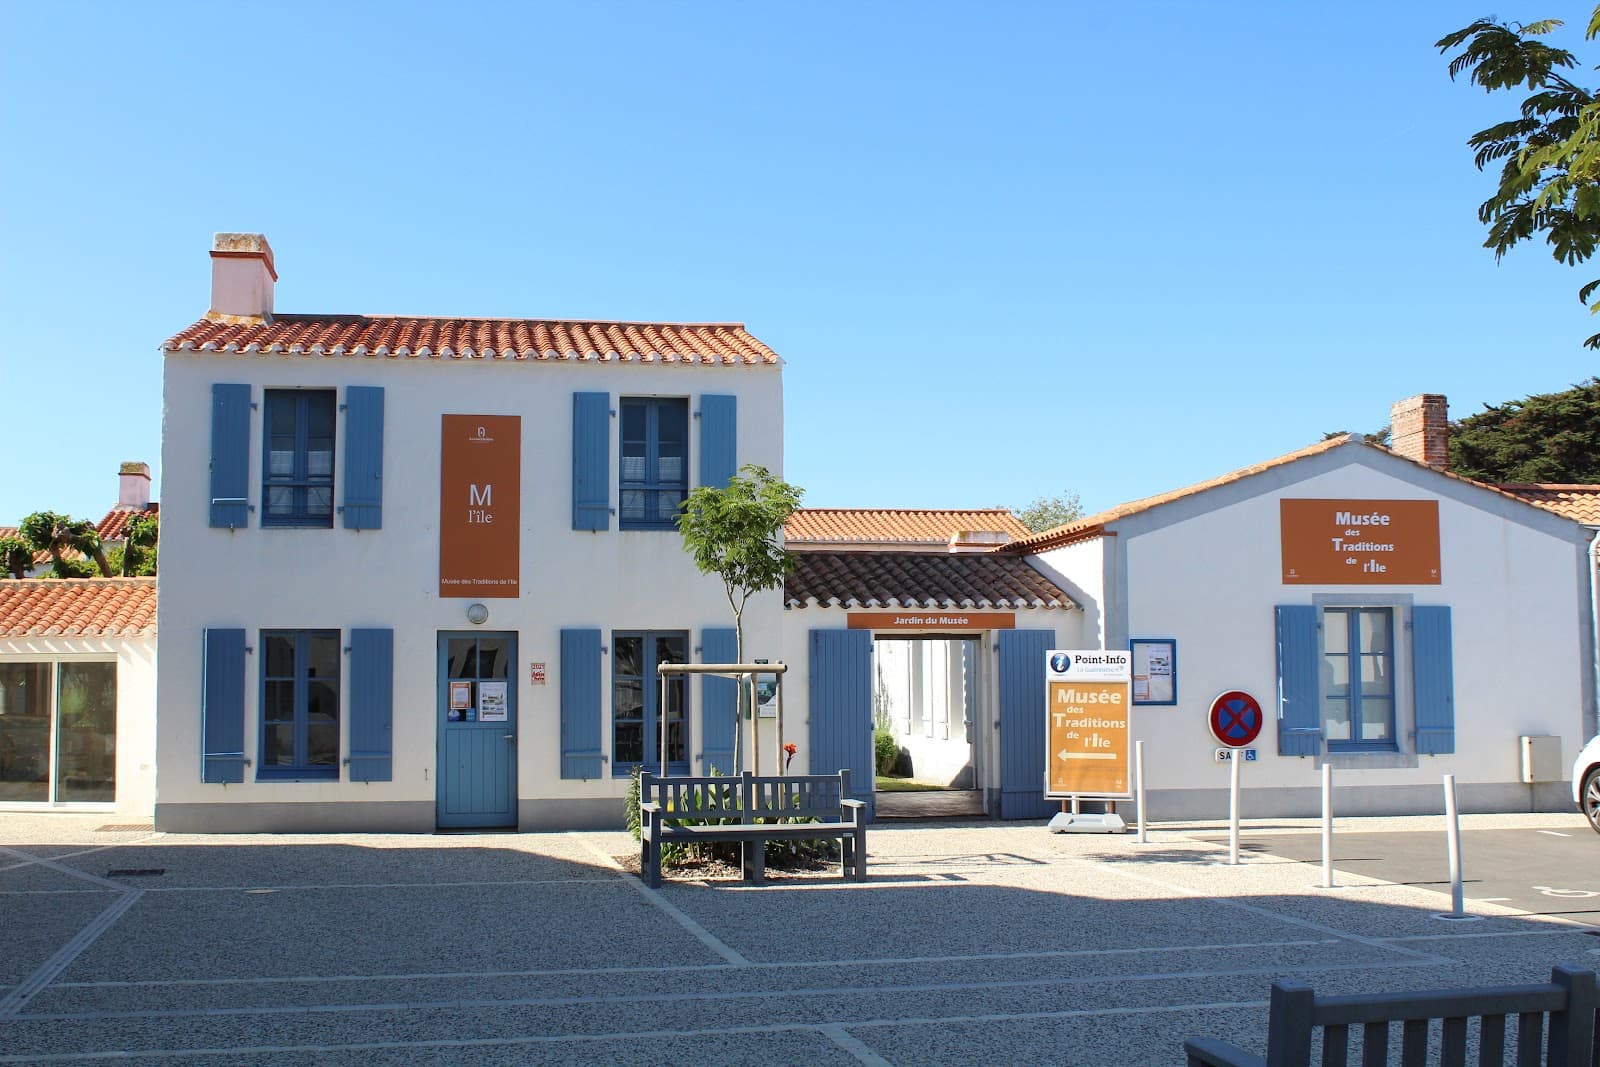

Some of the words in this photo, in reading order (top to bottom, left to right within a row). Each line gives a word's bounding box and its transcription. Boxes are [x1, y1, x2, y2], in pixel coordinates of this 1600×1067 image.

[470, 484, 492, 506] M
[1335, 511, 1390, 526] Musée
[1332, 538, 1394, 552] Traditions
[1345, 557, 1357, 565] de
[894, 617, 923, 625] Jardin
[925, 617, 937, 625] du
[939, 616, 968, 625] Musée
[1075, 655, 1127, 664] Point-Info
[1057, 689, 1122, 704] Musée
[1066, 706, 1084, 714] des
[1053, 713, 1126, 729] Traditions
[1066, 731, 1080, 739] de
